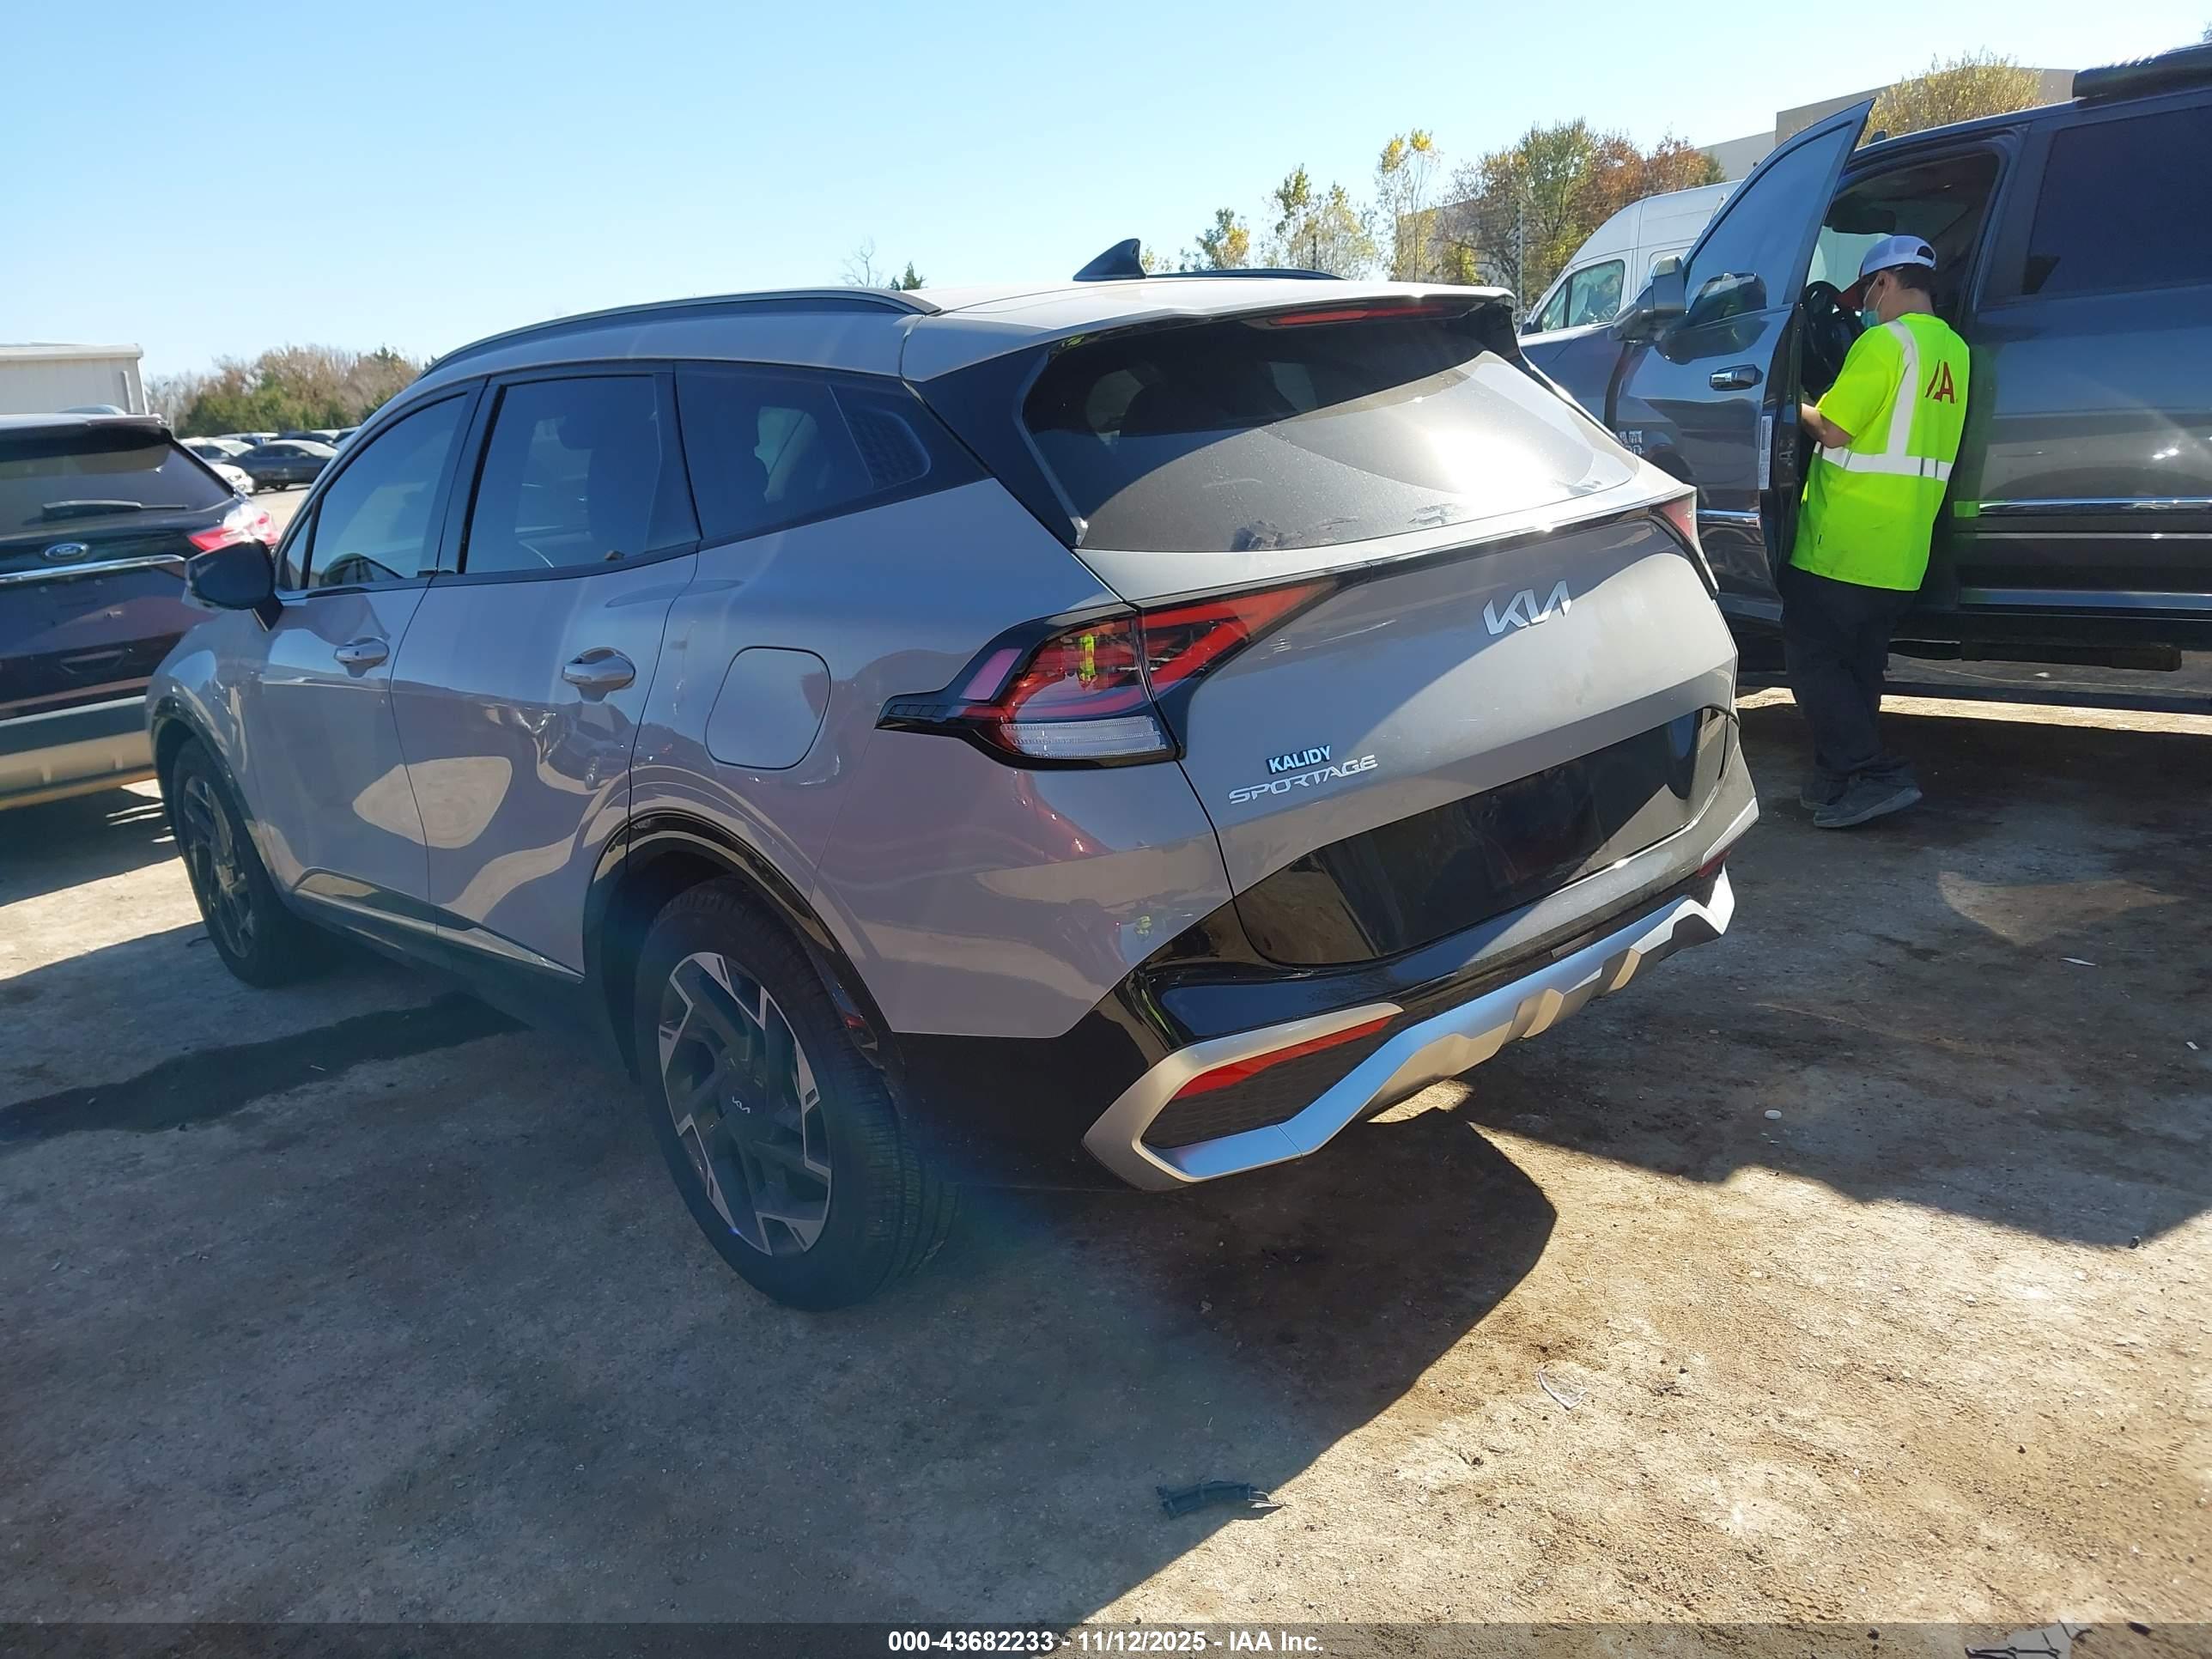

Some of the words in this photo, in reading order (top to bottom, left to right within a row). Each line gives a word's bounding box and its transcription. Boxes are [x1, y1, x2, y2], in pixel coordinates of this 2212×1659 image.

[1483, 580, 1572, 635] KIA
[1228, 754, 1379, 805] SPORTAGE
[1267, 745, 1331, 774] KALIDY
